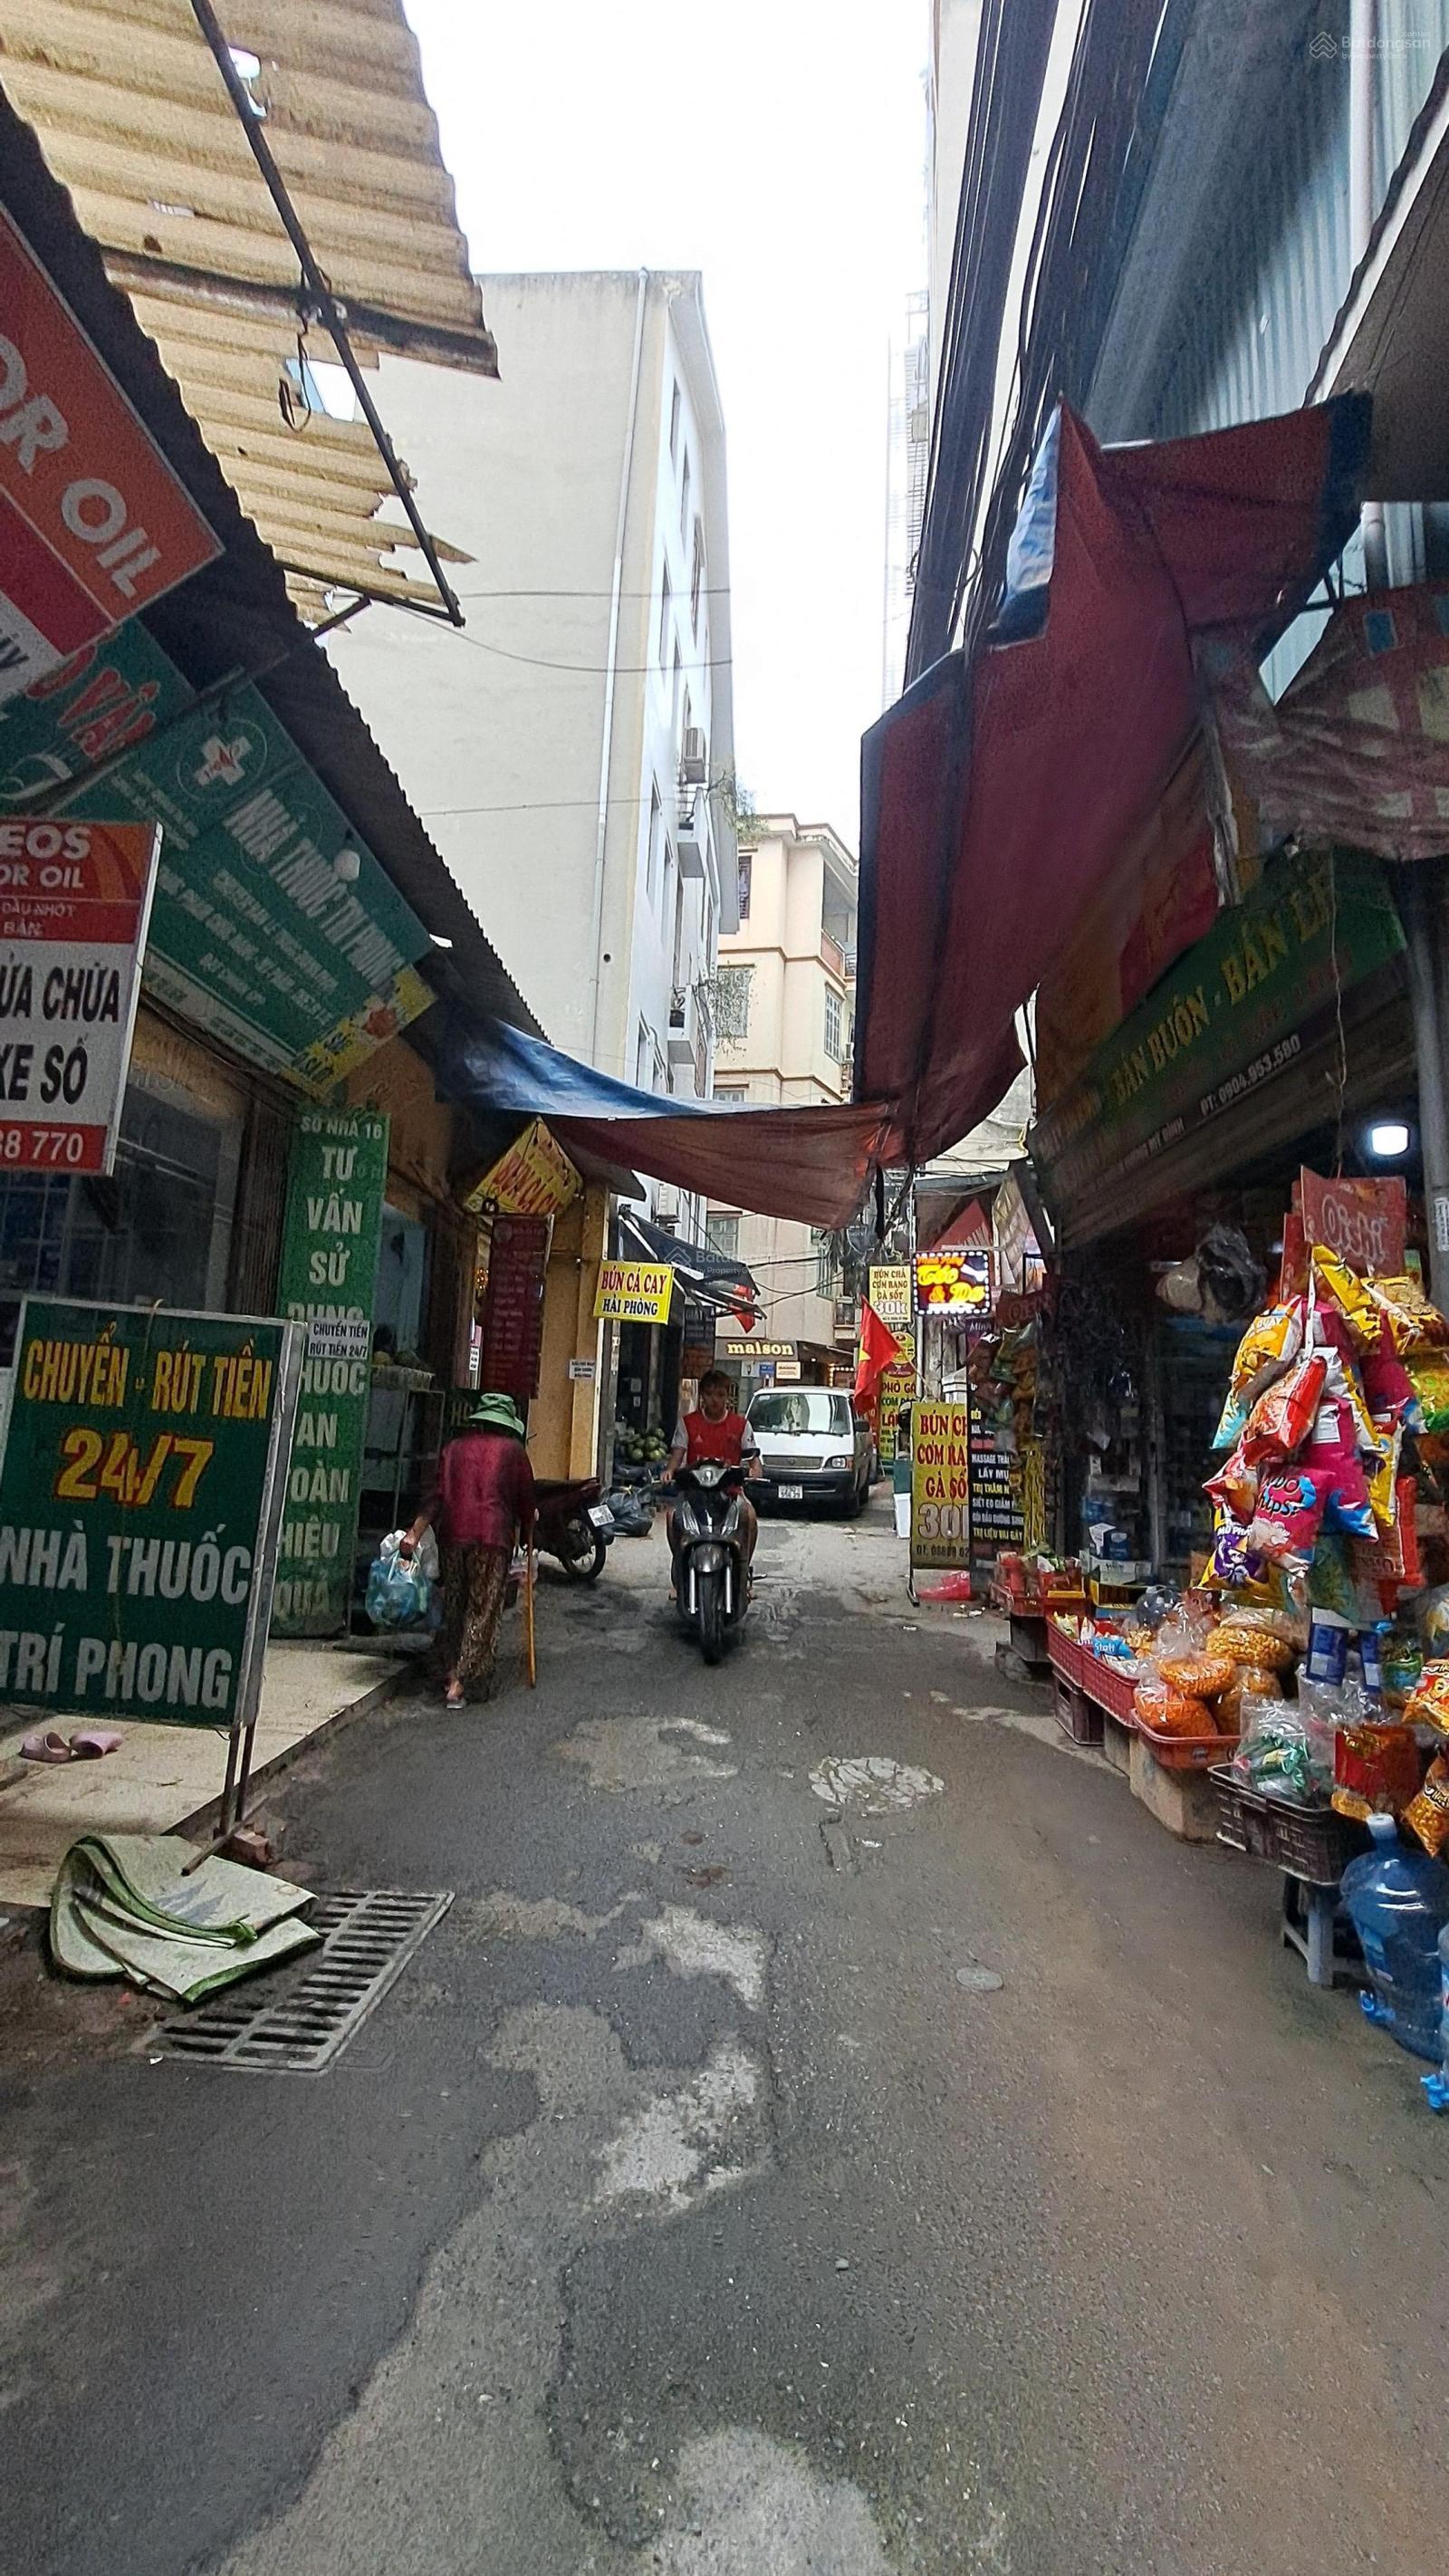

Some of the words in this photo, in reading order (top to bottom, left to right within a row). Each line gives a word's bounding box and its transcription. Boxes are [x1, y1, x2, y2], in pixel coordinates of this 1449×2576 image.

[61, 478, 161, 600] OIL
[40, 865, 85, 889] OIL
[40, 1033, 88, 1105] SỐ
[32, 1132, 83, 1163] 770
[321, 1145, 359, 1181] TƯ
[306, 1187, 363, 1235] VẤN
[309, 1241, 350, 1287] SỬ
[601, 1266, 623, 1290] BÚN
[626, 1266, 641, 1293] CÁ
[644, 1274, 667, 1294] CAY
[602, 1294, 621, 1313] HẢI
[623, 1297, 658, 1315] PHÒNG
[727, 1341, 794, 1357] maison
[24, 1322, 130, 1408] CHUYỂN
[150, 1338, 206, 1416] RÚT
[212, 1334, 273, 1420] TIỀN
[296, 1411, 338, 1448] AN
[919, 1410, 949, 1437] BÚN
[58, 1429, 214, 1507] 24/7
[917, 1440, 945, 1466] CƠM
[288, 1459, 350, 1504] OÀN
[926, 1470, 945, 1499] GÀ
[950, 1468, 968, 1499] SỐ
[0, 1519, 88, 1592] NHÀ
[106, 1523, 251, 1605] THUỐC
[74, 1636, 234, 1710] PHONG
